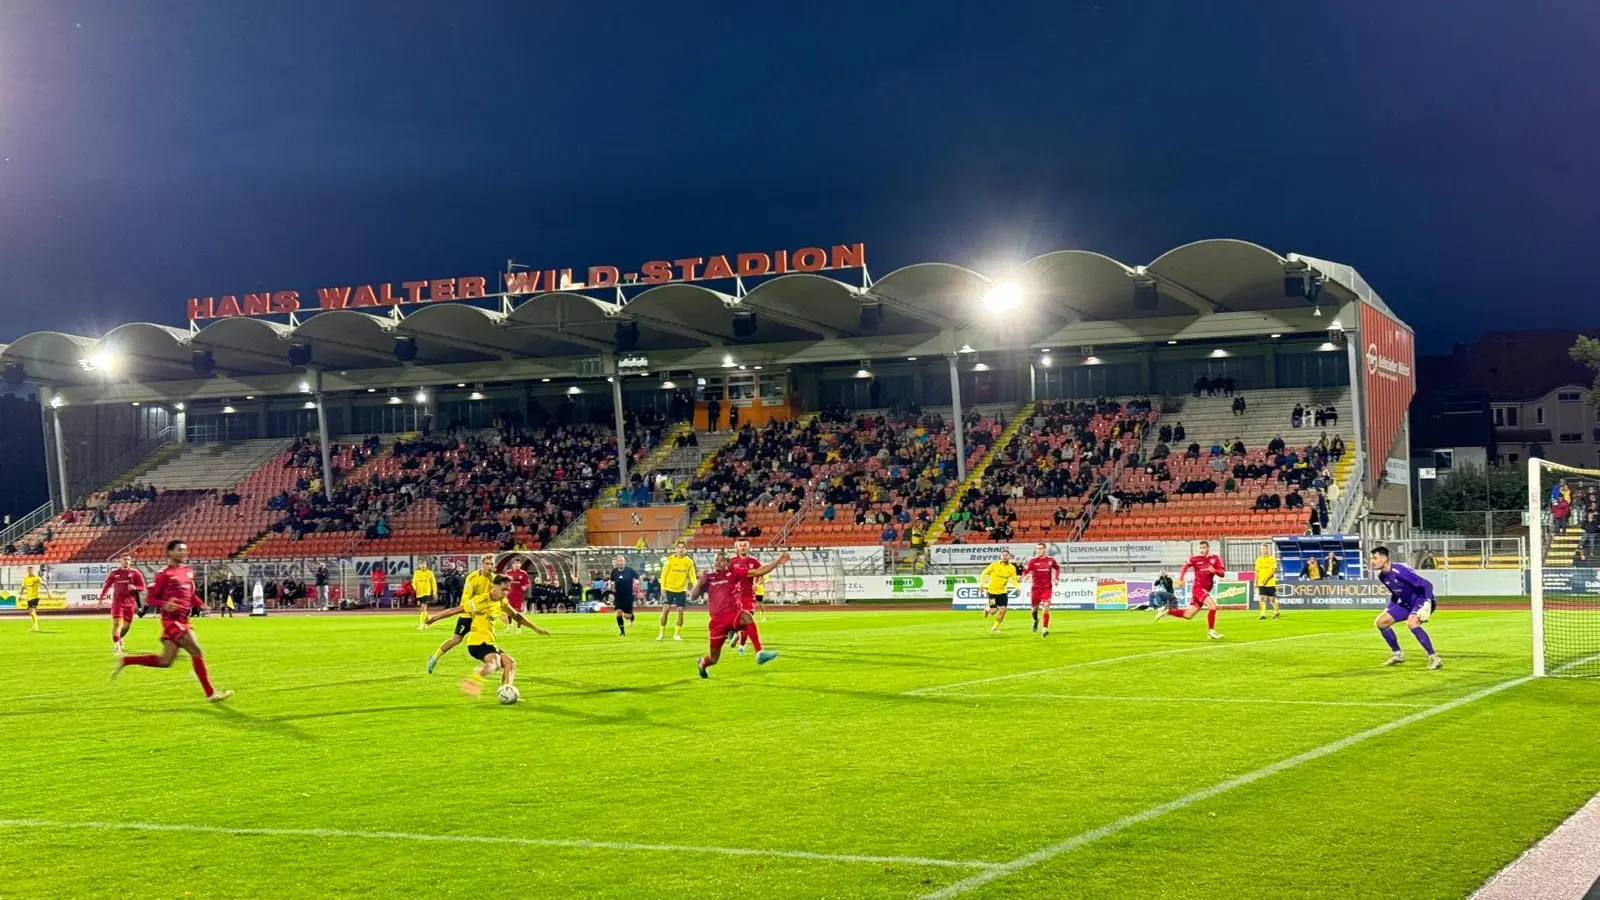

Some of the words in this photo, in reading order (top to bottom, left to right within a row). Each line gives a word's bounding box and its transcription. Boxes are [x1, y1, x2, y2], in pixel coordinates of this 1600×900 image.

[187, 289, 301, 319] HANS
[317, 275, 487, 310] WALTER
[503, 242, 865, 294] WILD-STADION
